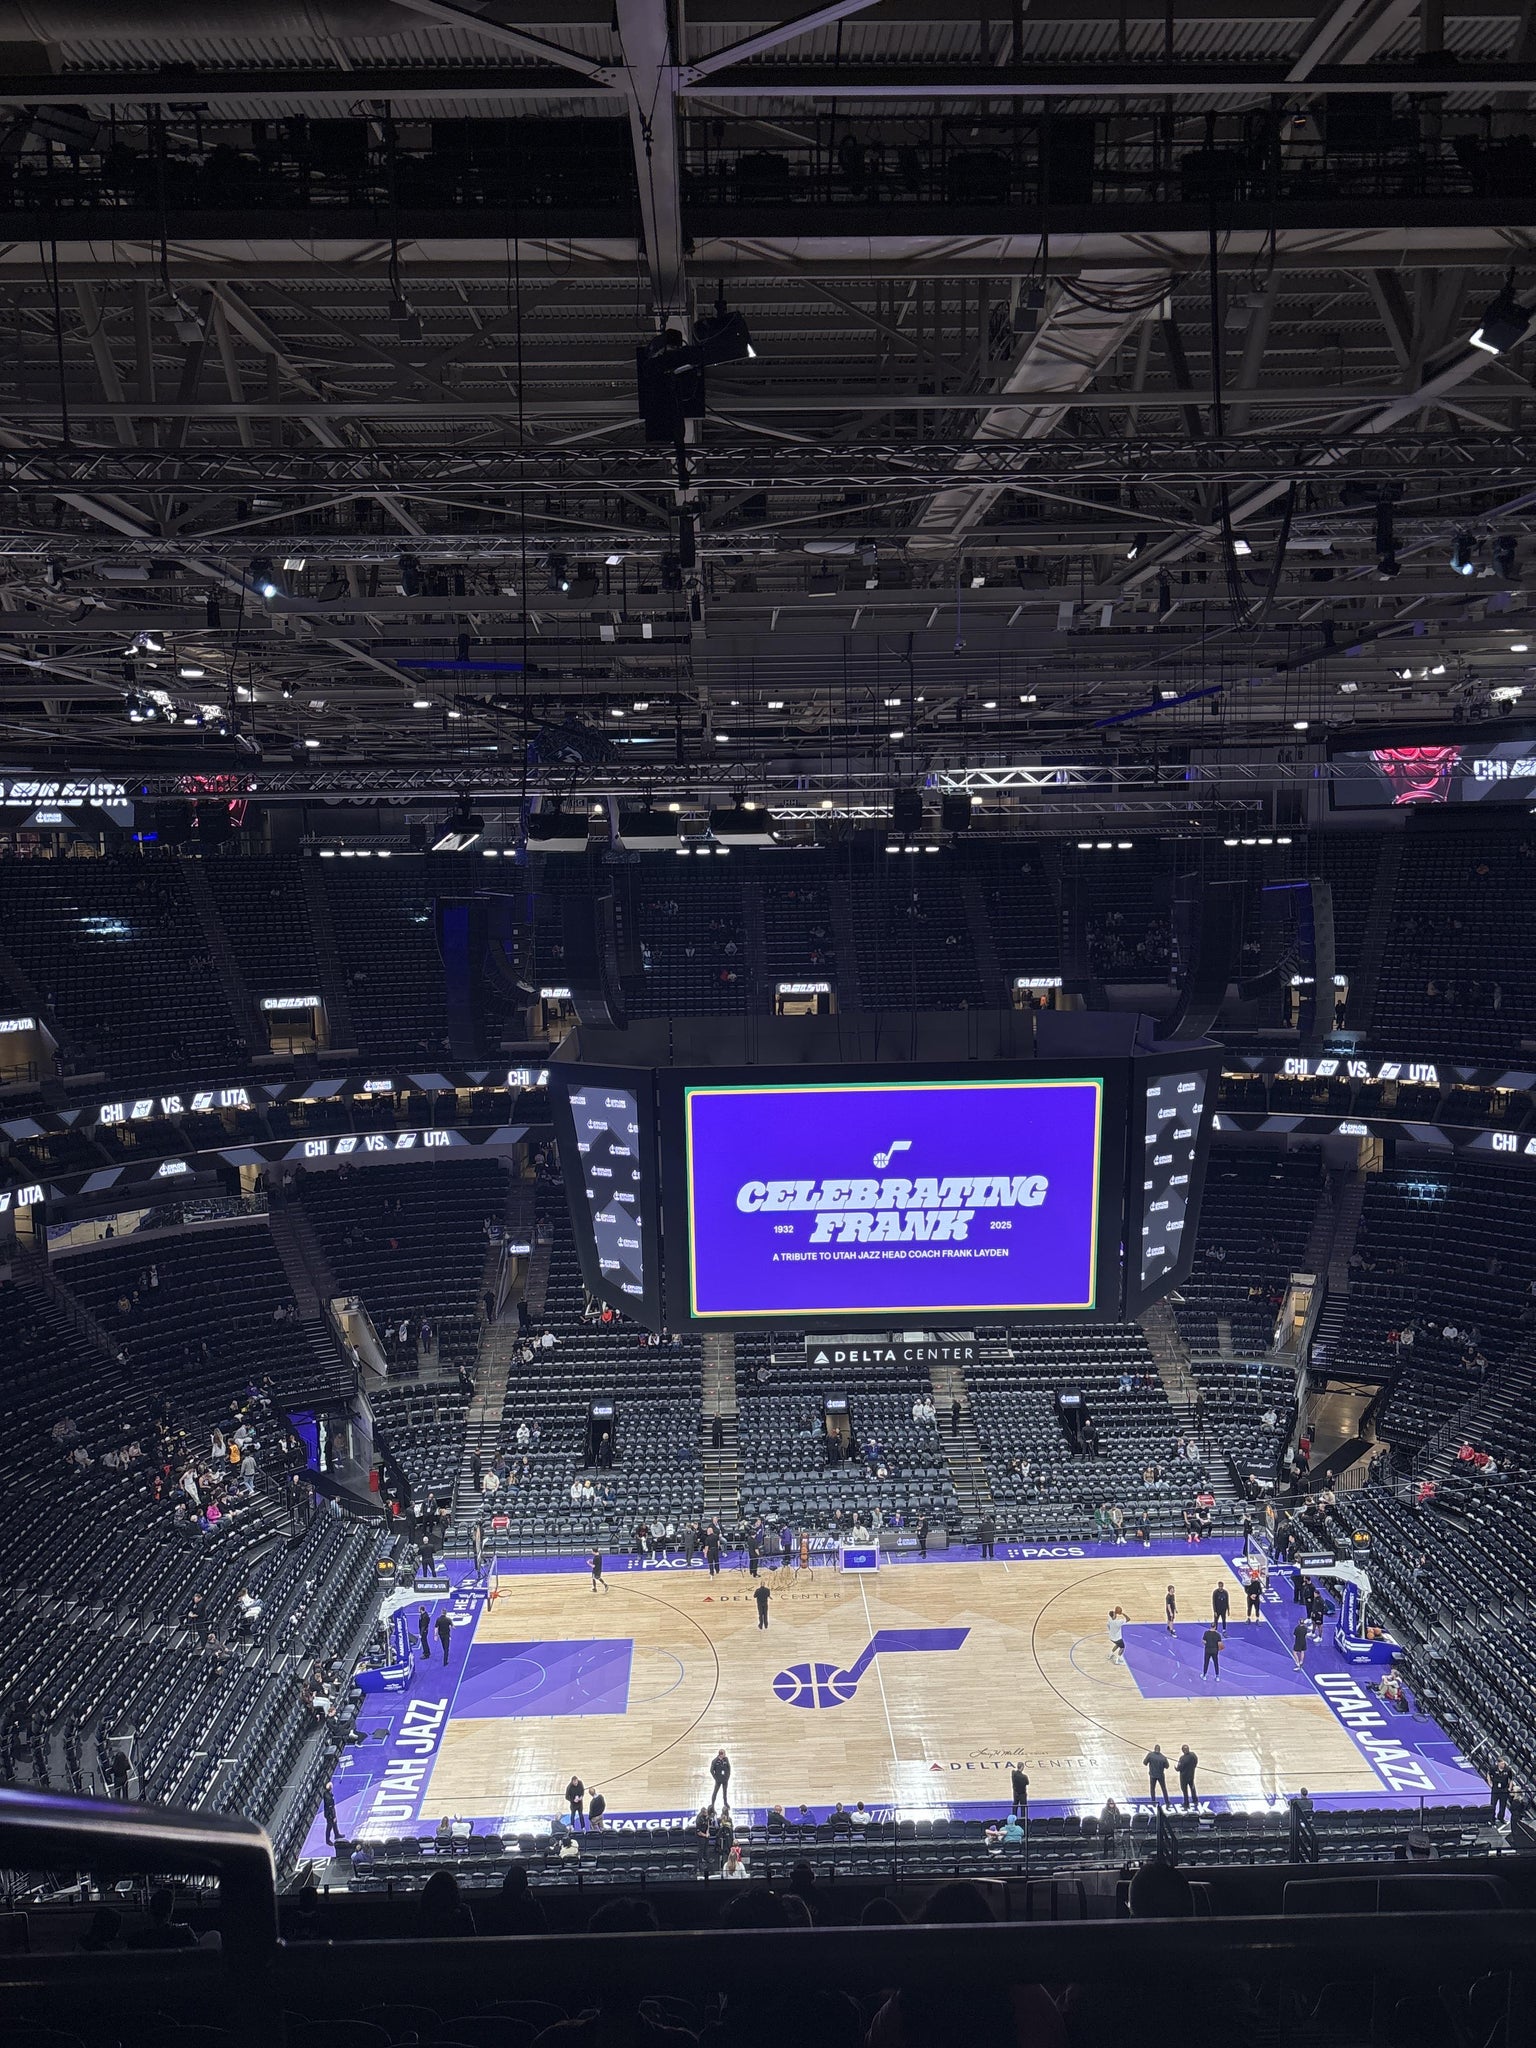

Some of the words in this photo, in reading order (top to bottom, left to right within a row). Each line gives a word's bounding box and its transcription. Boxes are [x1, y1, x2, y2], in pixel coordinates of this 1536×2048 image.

[1473, 759, 1507, 781] CHI
[304, 997, 318, 1007] UTA
[508, 1070, 530, 1086] CHI
[1284, 1057, 1308, 1075] CHI
[1347, 1060, 1370, 1078] VS.
[1408, 1063, 1438, 1082] UTA
[101, 1103, 124, 1123] CHI
[161, 1095, 184, 1114] VS.
[221, 1088, 249, 1107] UTA
[305, 1139, 328, 1157] CHI
[364, 1135, 388, 1152] VS.
[424, 1131, 450, 1148] UTA
[1492, 1132, 1517, 1152] CHI
[17, 1184, 44, 1207] UTA
[736, 1175, 1049, 1213] CELEBRATING
[773, 1225, 794, 1234] 1932
[809, 1210, 975, 1243] FRANK
[990, 1221, 1012, 1230] 2025
[772, 1253, 780, 1261] A
[781, 1252, 817, 1261] TRIBUTE
[819, 1252, 832, 1260] TO
[833, 1251, 856, 1260] UTAH
[857, 1251, 881, 1260] JAZZ
[881, 1250, 906, 1259] HEAD
[908, 1249, 940, 1259] COACH
[941, 1249, 972, 1258] FRANK
[974, 1248, 1009, 1257] LAYDEN
[834, 1350, 897, 1363] DELTA
[903, 1348, 974, 1361] CENTER
[642, 1557, 704, 1568] PACS
[1022, 1547, 1085, 1558] PACS
[780, 1592, 841, 1600] CENTER
[395, 1698, 449, 1754] JAZZ
[1314, 1673, 1387, 1726] UTAH
[1355, 1731, 1436, 1792] JAZZ
[950, 1760, 1016, 1771] DELTA
[1024, 1758, 1099, 1769] CENTER
[367, 1758, 429, 1822] UTAH
